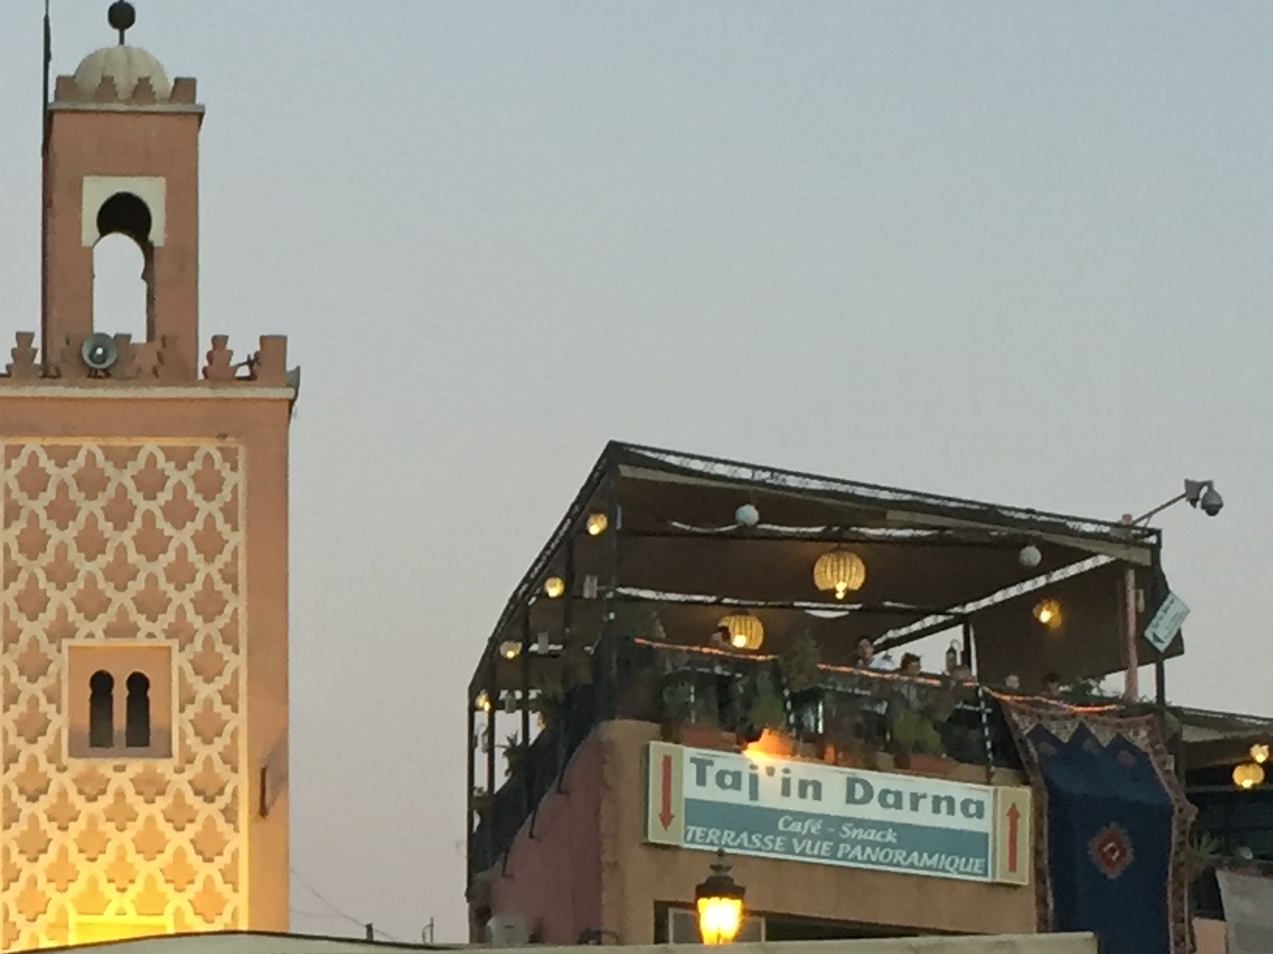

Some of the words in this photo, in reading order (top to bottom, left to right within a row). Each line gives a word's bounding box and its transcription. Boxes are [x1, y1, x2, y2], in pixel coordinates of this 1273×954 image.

[690, 757, 822, 801] Taj'in
[846, 776, 985, 819] Darna
[685, 825, 787, 851] TERRASSE
[792, 838, 833, 856] VUE
[837, 843, 986, 875] PANORAMIQUE
[778, 815, 823, 835] Café
[839, 822, 898, 843] Snack
